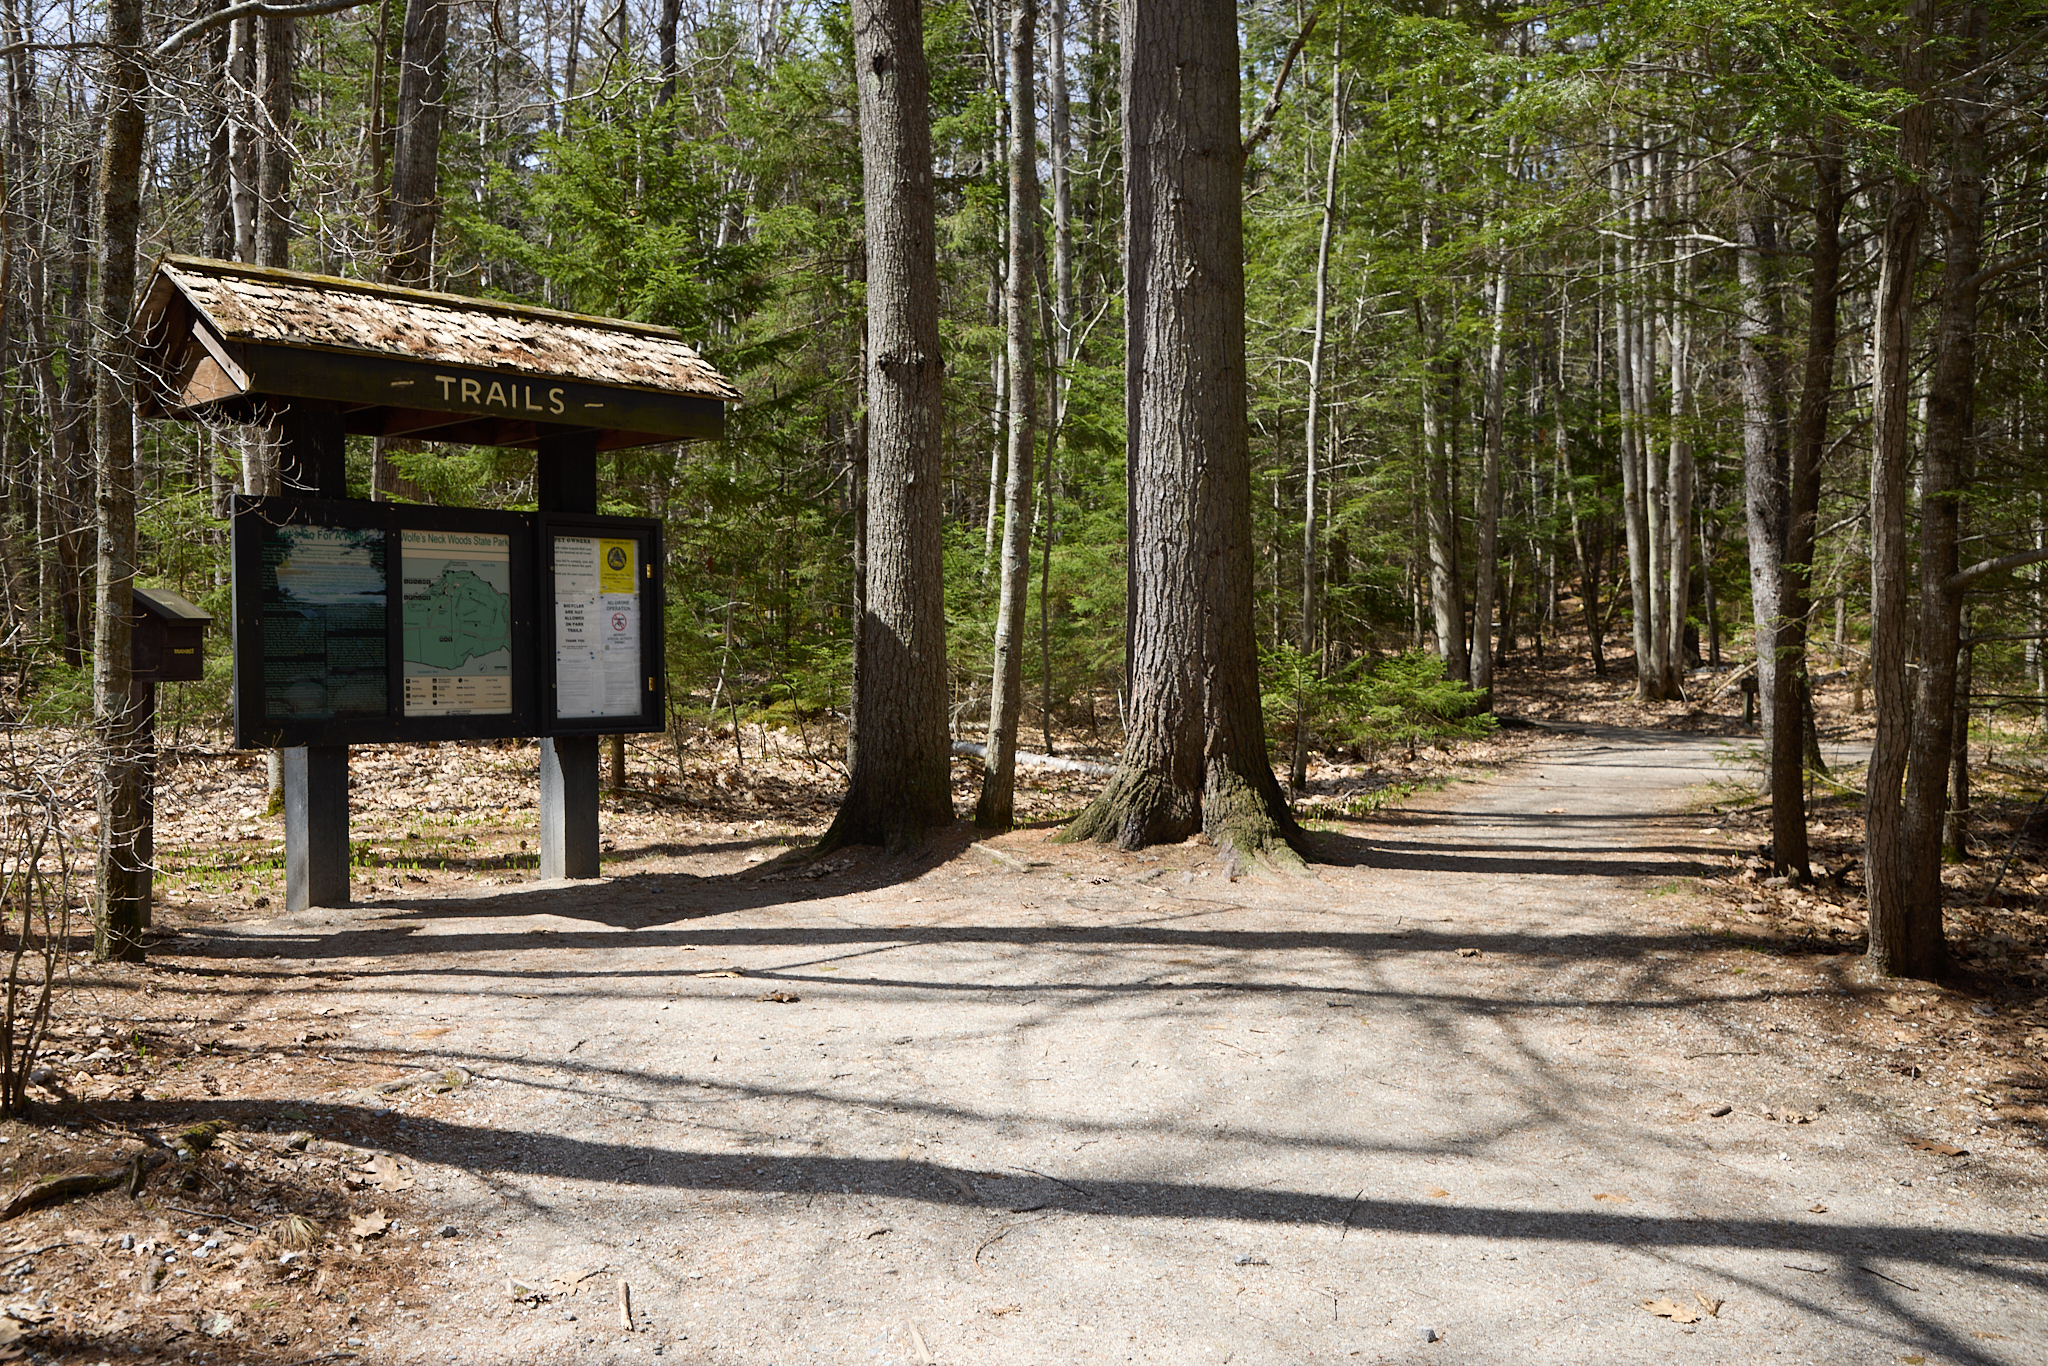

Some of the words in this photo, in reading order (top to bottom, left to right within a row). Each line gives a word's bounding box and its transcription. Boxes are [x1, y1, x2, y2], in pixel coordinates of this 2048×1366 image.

[435, 375, 564, 414] TRAILS
[278, 529, 300, 539] Let's
[302, 529, 315, 541] Go
[317, 530, 331, 540] For
[335, 531, 342, 540] A
[401, 532, 427, 543] Wolfe's
[428, 534, 447, 544] Neck
[448, 535, 472, 545] Woods
[474, 536, 492, 547] State
[493, 537, 509, 547] Park
